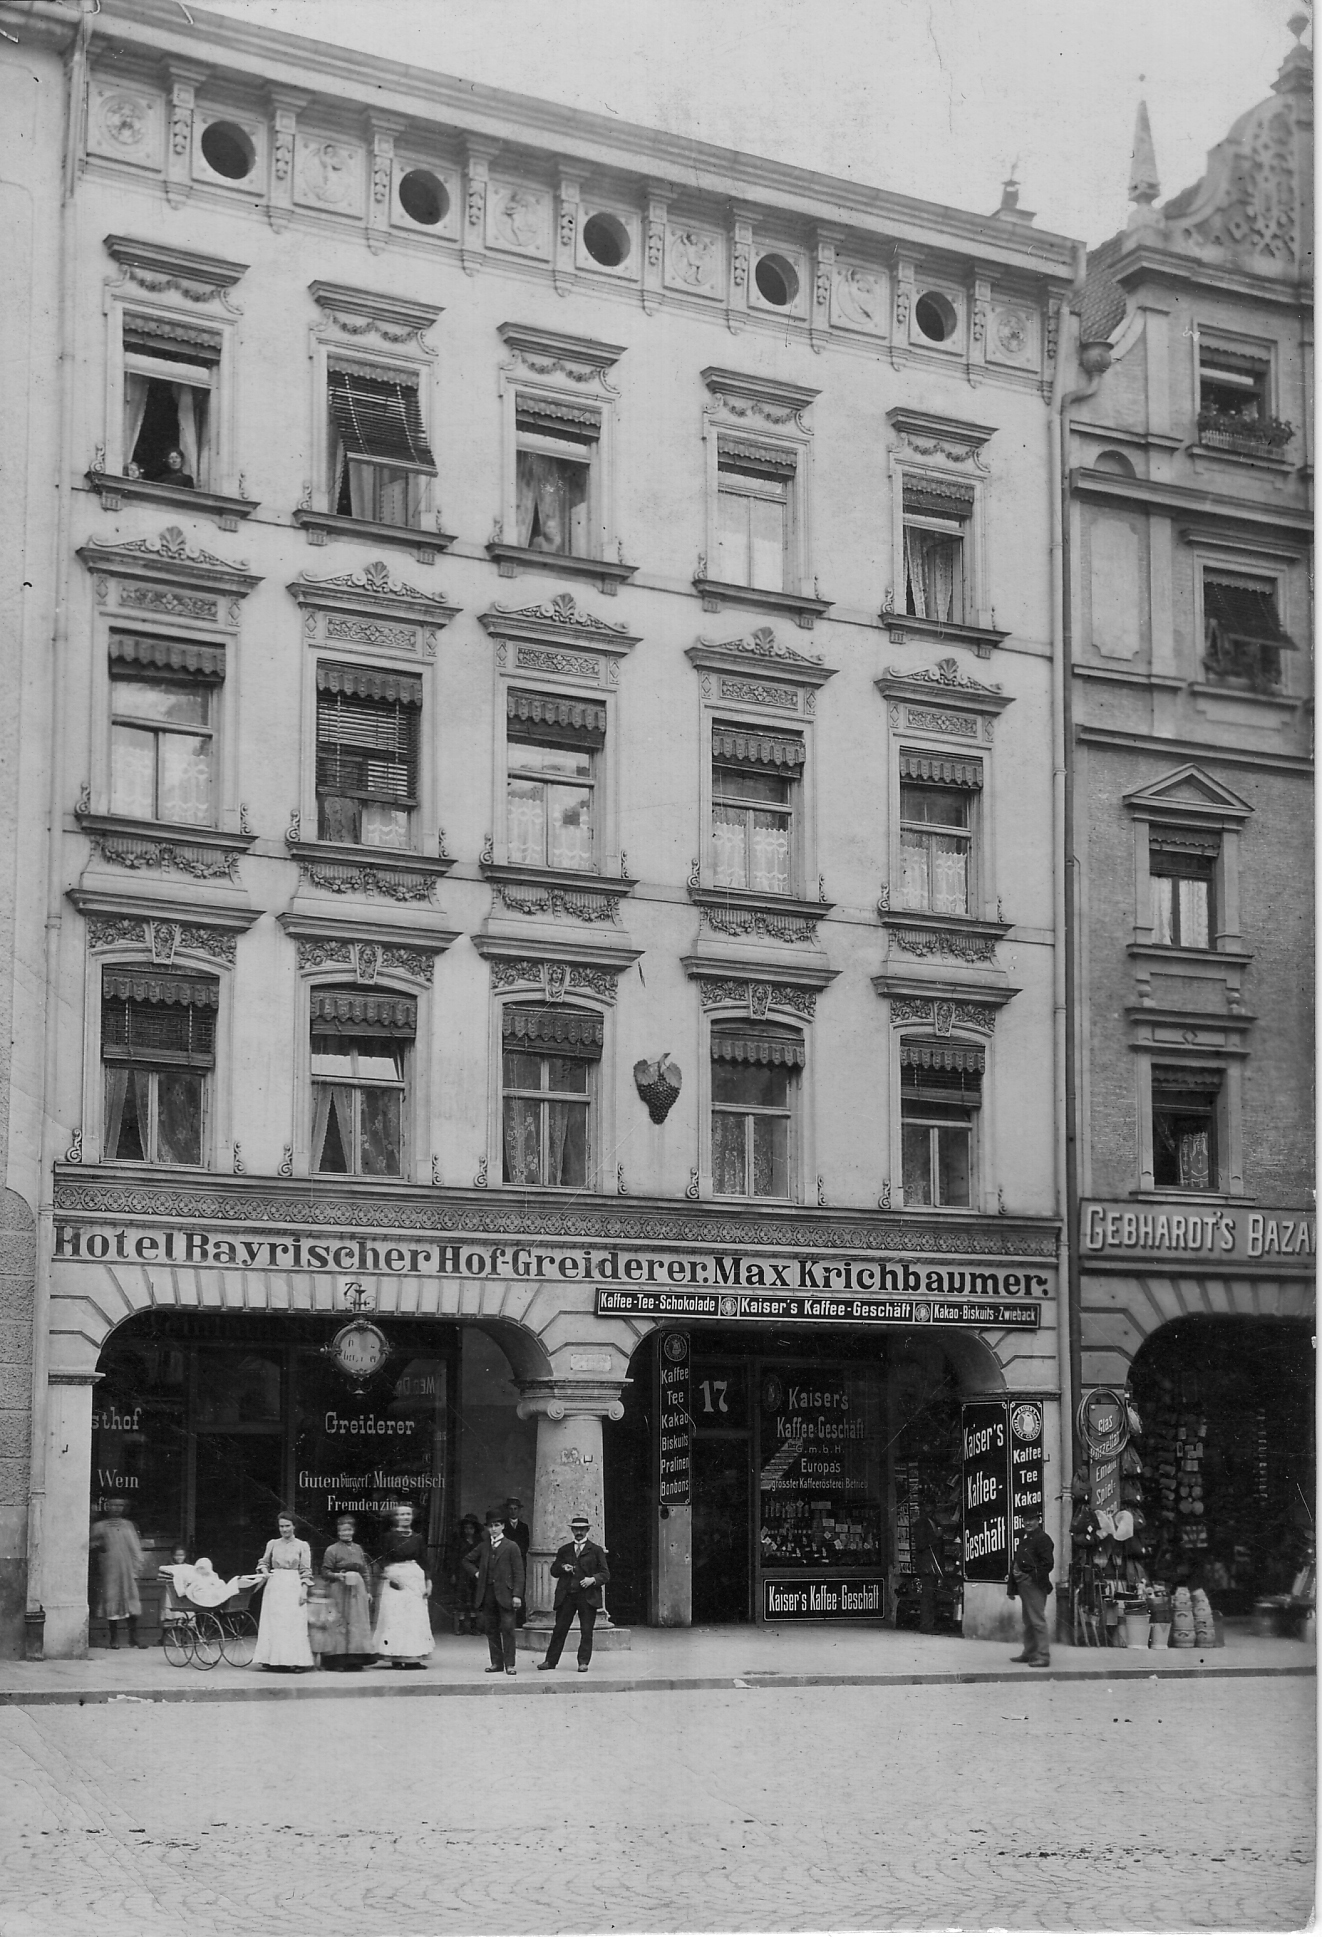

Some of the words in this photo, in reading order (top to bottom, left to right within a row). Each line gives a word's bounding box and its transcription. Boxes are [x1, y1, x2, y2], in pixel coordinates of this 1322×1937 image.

[1085, 1205, 1236, 1252] GEBHARDT'S
[1247, 1213, 1317, 1258] BAZA
[53, 1225, 177, 1262] Hotel
[182, 1231, 431, 1274] Bayrischer
[713, 1256, 791, 1288] Max
[740, 1297, 798, 1315] Kaiser's
[804, 1299, 911, 1319] Kaffee-Geschäft
[661, 1366, 689, 1385] Kaffee
[667, 1390, 684, 1406] Tee
[698, 1380, 729, 1413] 17
[788, 1386, 849, 1410] Kaiser's
[325, 1411, 415, 1435] Greiderer
[661, 1412, 689, 1430] Kakao
[661, 1433, 689, 1451] Biskuits
[963, 1423, 1004, 1461] Kaiser's
[660, 1456, 690, 1475] Pralinen
[1013, 1446, 1042, 1464] Kaffee
[97, 1468, 140, 1488] Wein
[373, 1470, 446, 1493] Mittagstisch
[1019, 1469, 1038, 1484] Tee
[661, 1478, 689, 1497] Bonbons
[1014, 1490, 1042, 1508] Kakao
[964, 1516, 1006, 1562] Geschäft
[768, 1584, 807, 1612] Kaiser's
[809, 1583, 880, 1612] Kaffee-Geschäft
